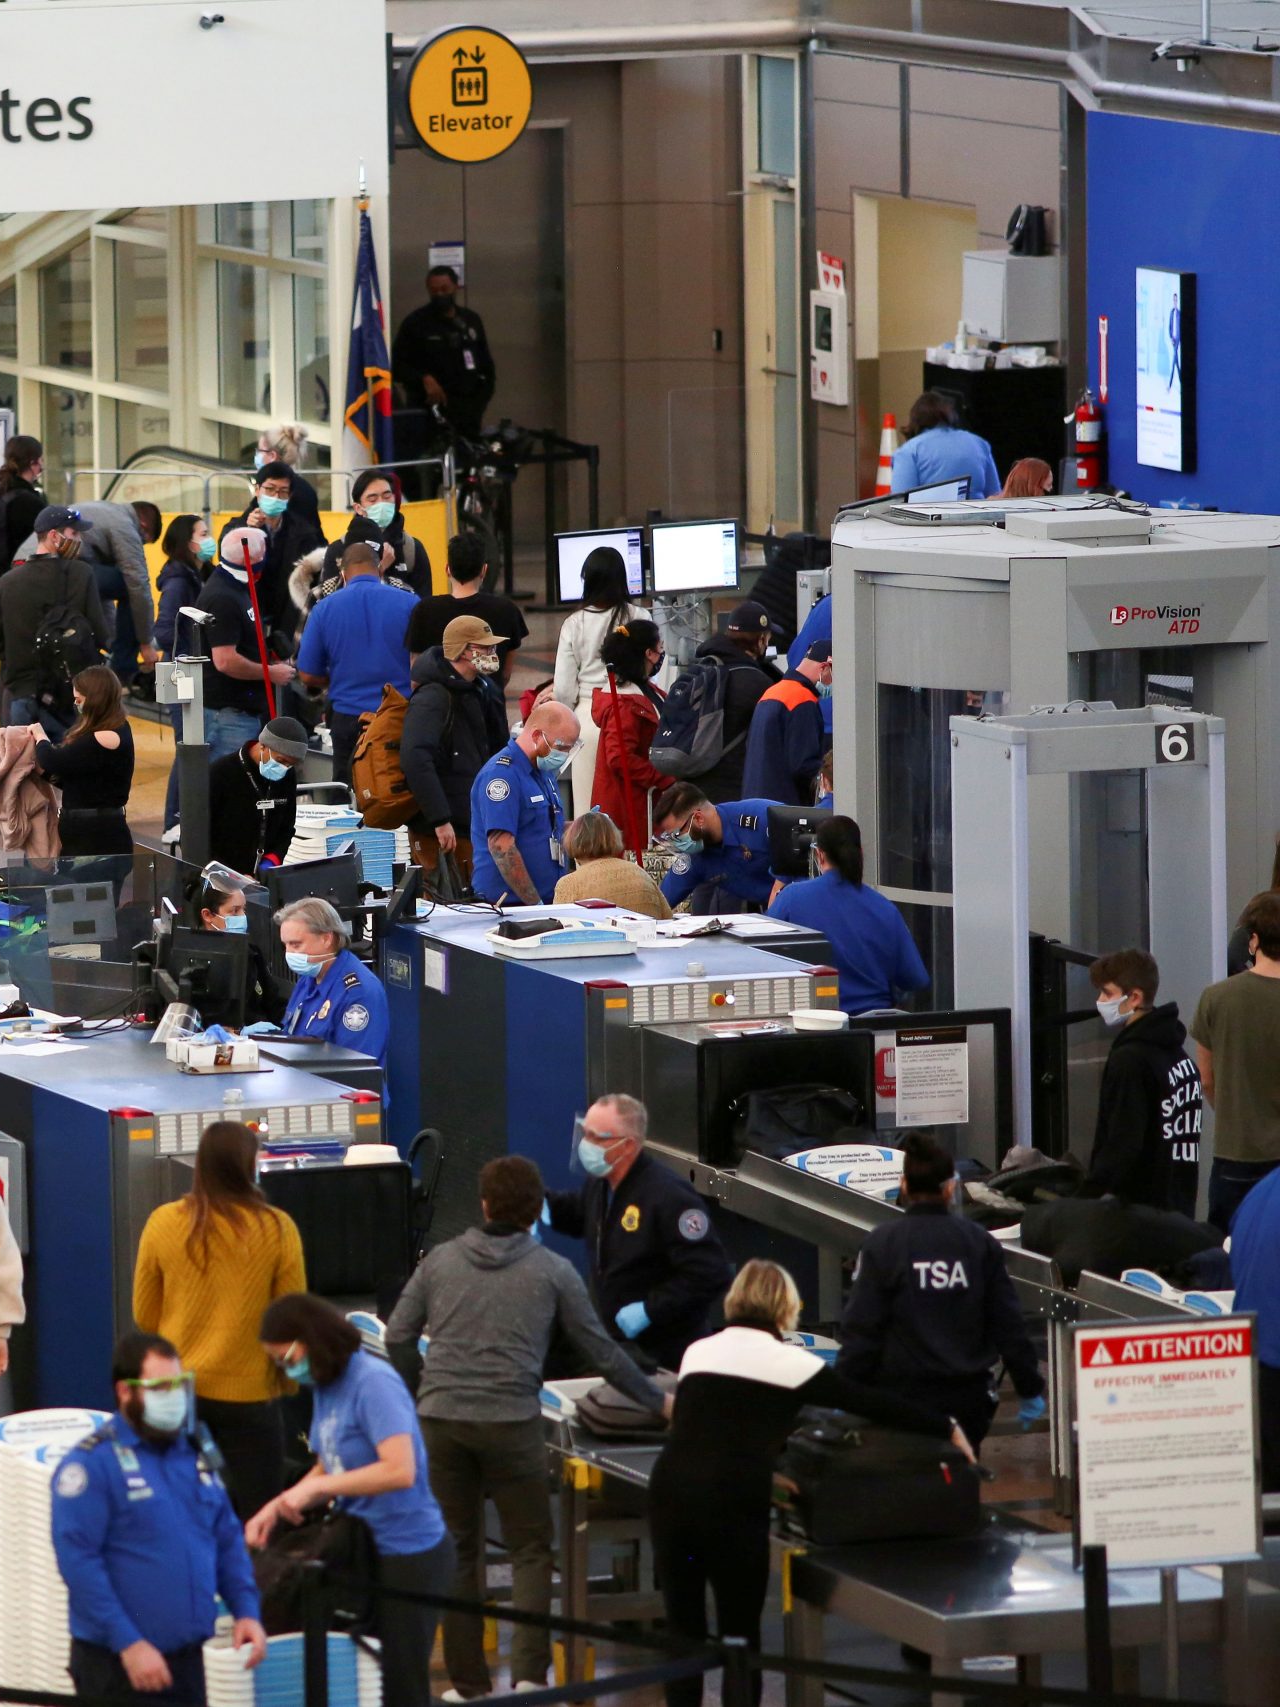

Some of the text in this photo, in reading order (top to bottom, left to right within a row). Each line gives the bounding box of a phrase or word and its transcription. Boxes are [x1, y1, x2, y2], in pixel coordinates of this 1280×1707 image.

[428, 113, 513, 132] Elevator
[1131, 604, 1201, 620] ProVision
[1168, 619, 1200, 634] ATD
[1162, 724, 1189, 762] 6
[1168, 1058, 1196, 1087] ANTI
[913, 1260, 969, 1289] TSA
[1121, 1332, 1243, 1361] ATTENTION
[1093, 1367, 1237, 1388] EFFECTIVE IMMEDIATELY
